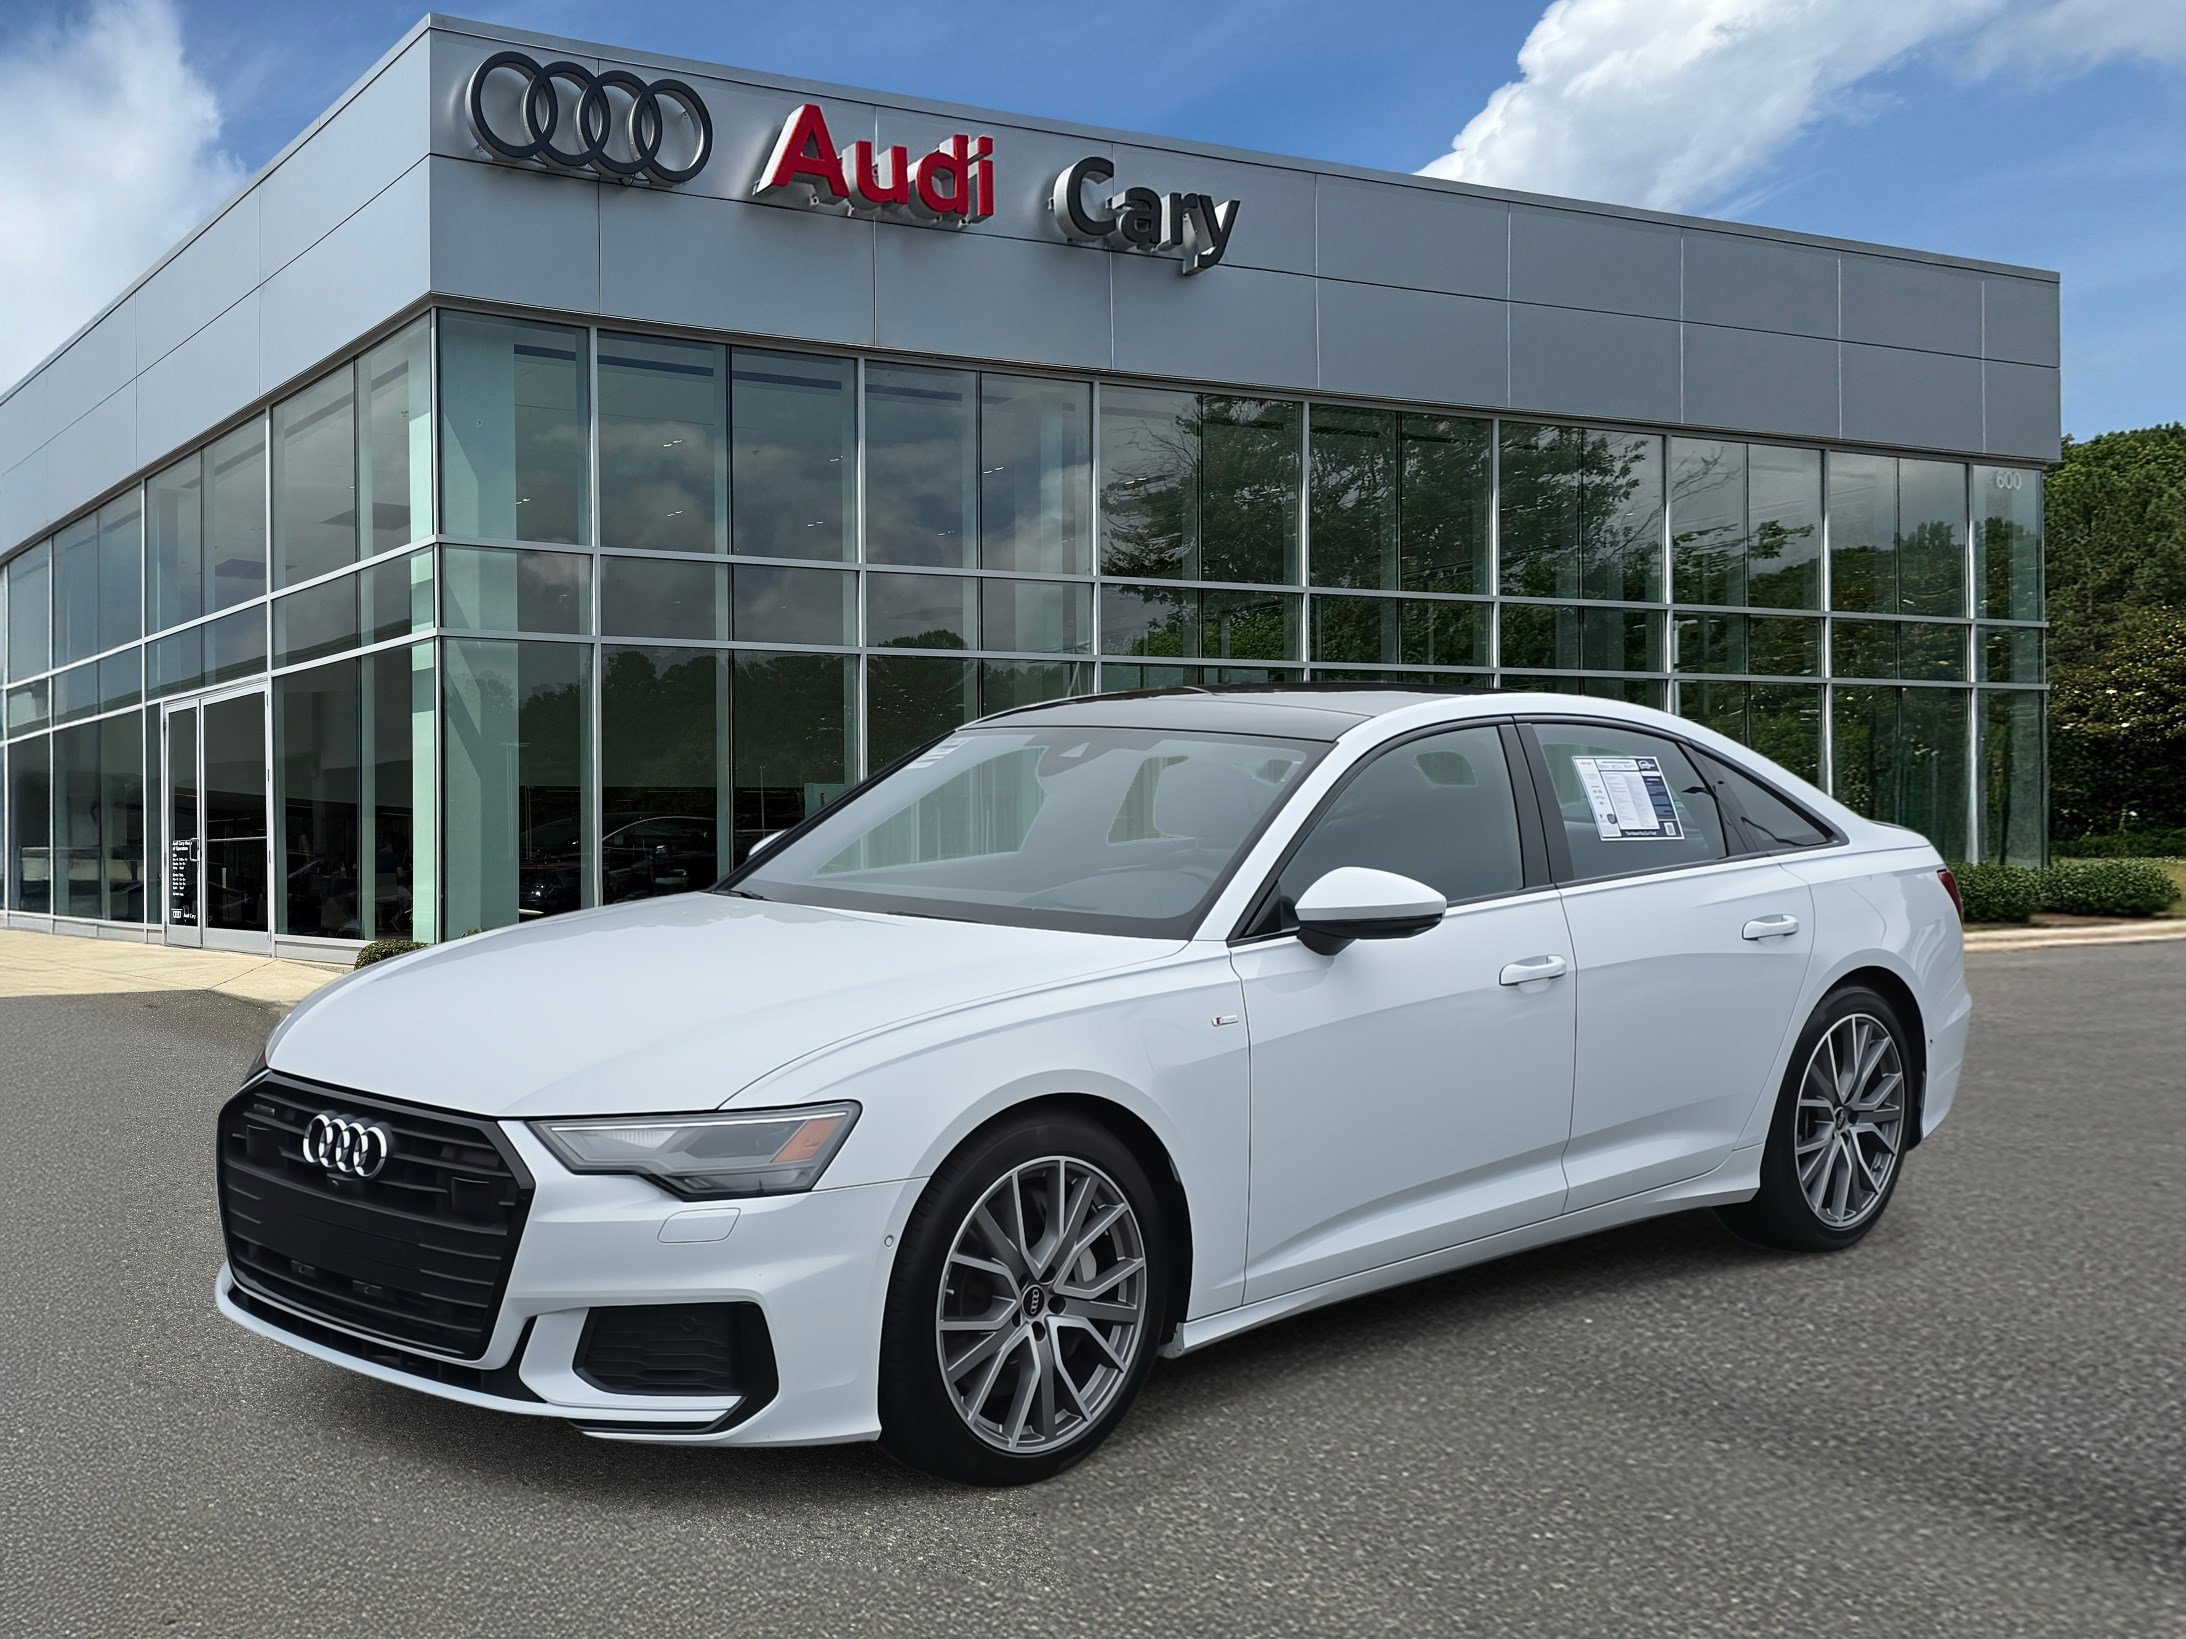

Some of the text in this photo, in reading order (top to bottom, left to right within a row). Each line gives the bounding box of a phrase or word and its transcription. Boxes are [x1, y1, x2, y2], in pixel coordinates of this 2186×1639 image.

[757, 103, 1240, 275] Audi Cary
[1996, 470, 2022, 490] 600
